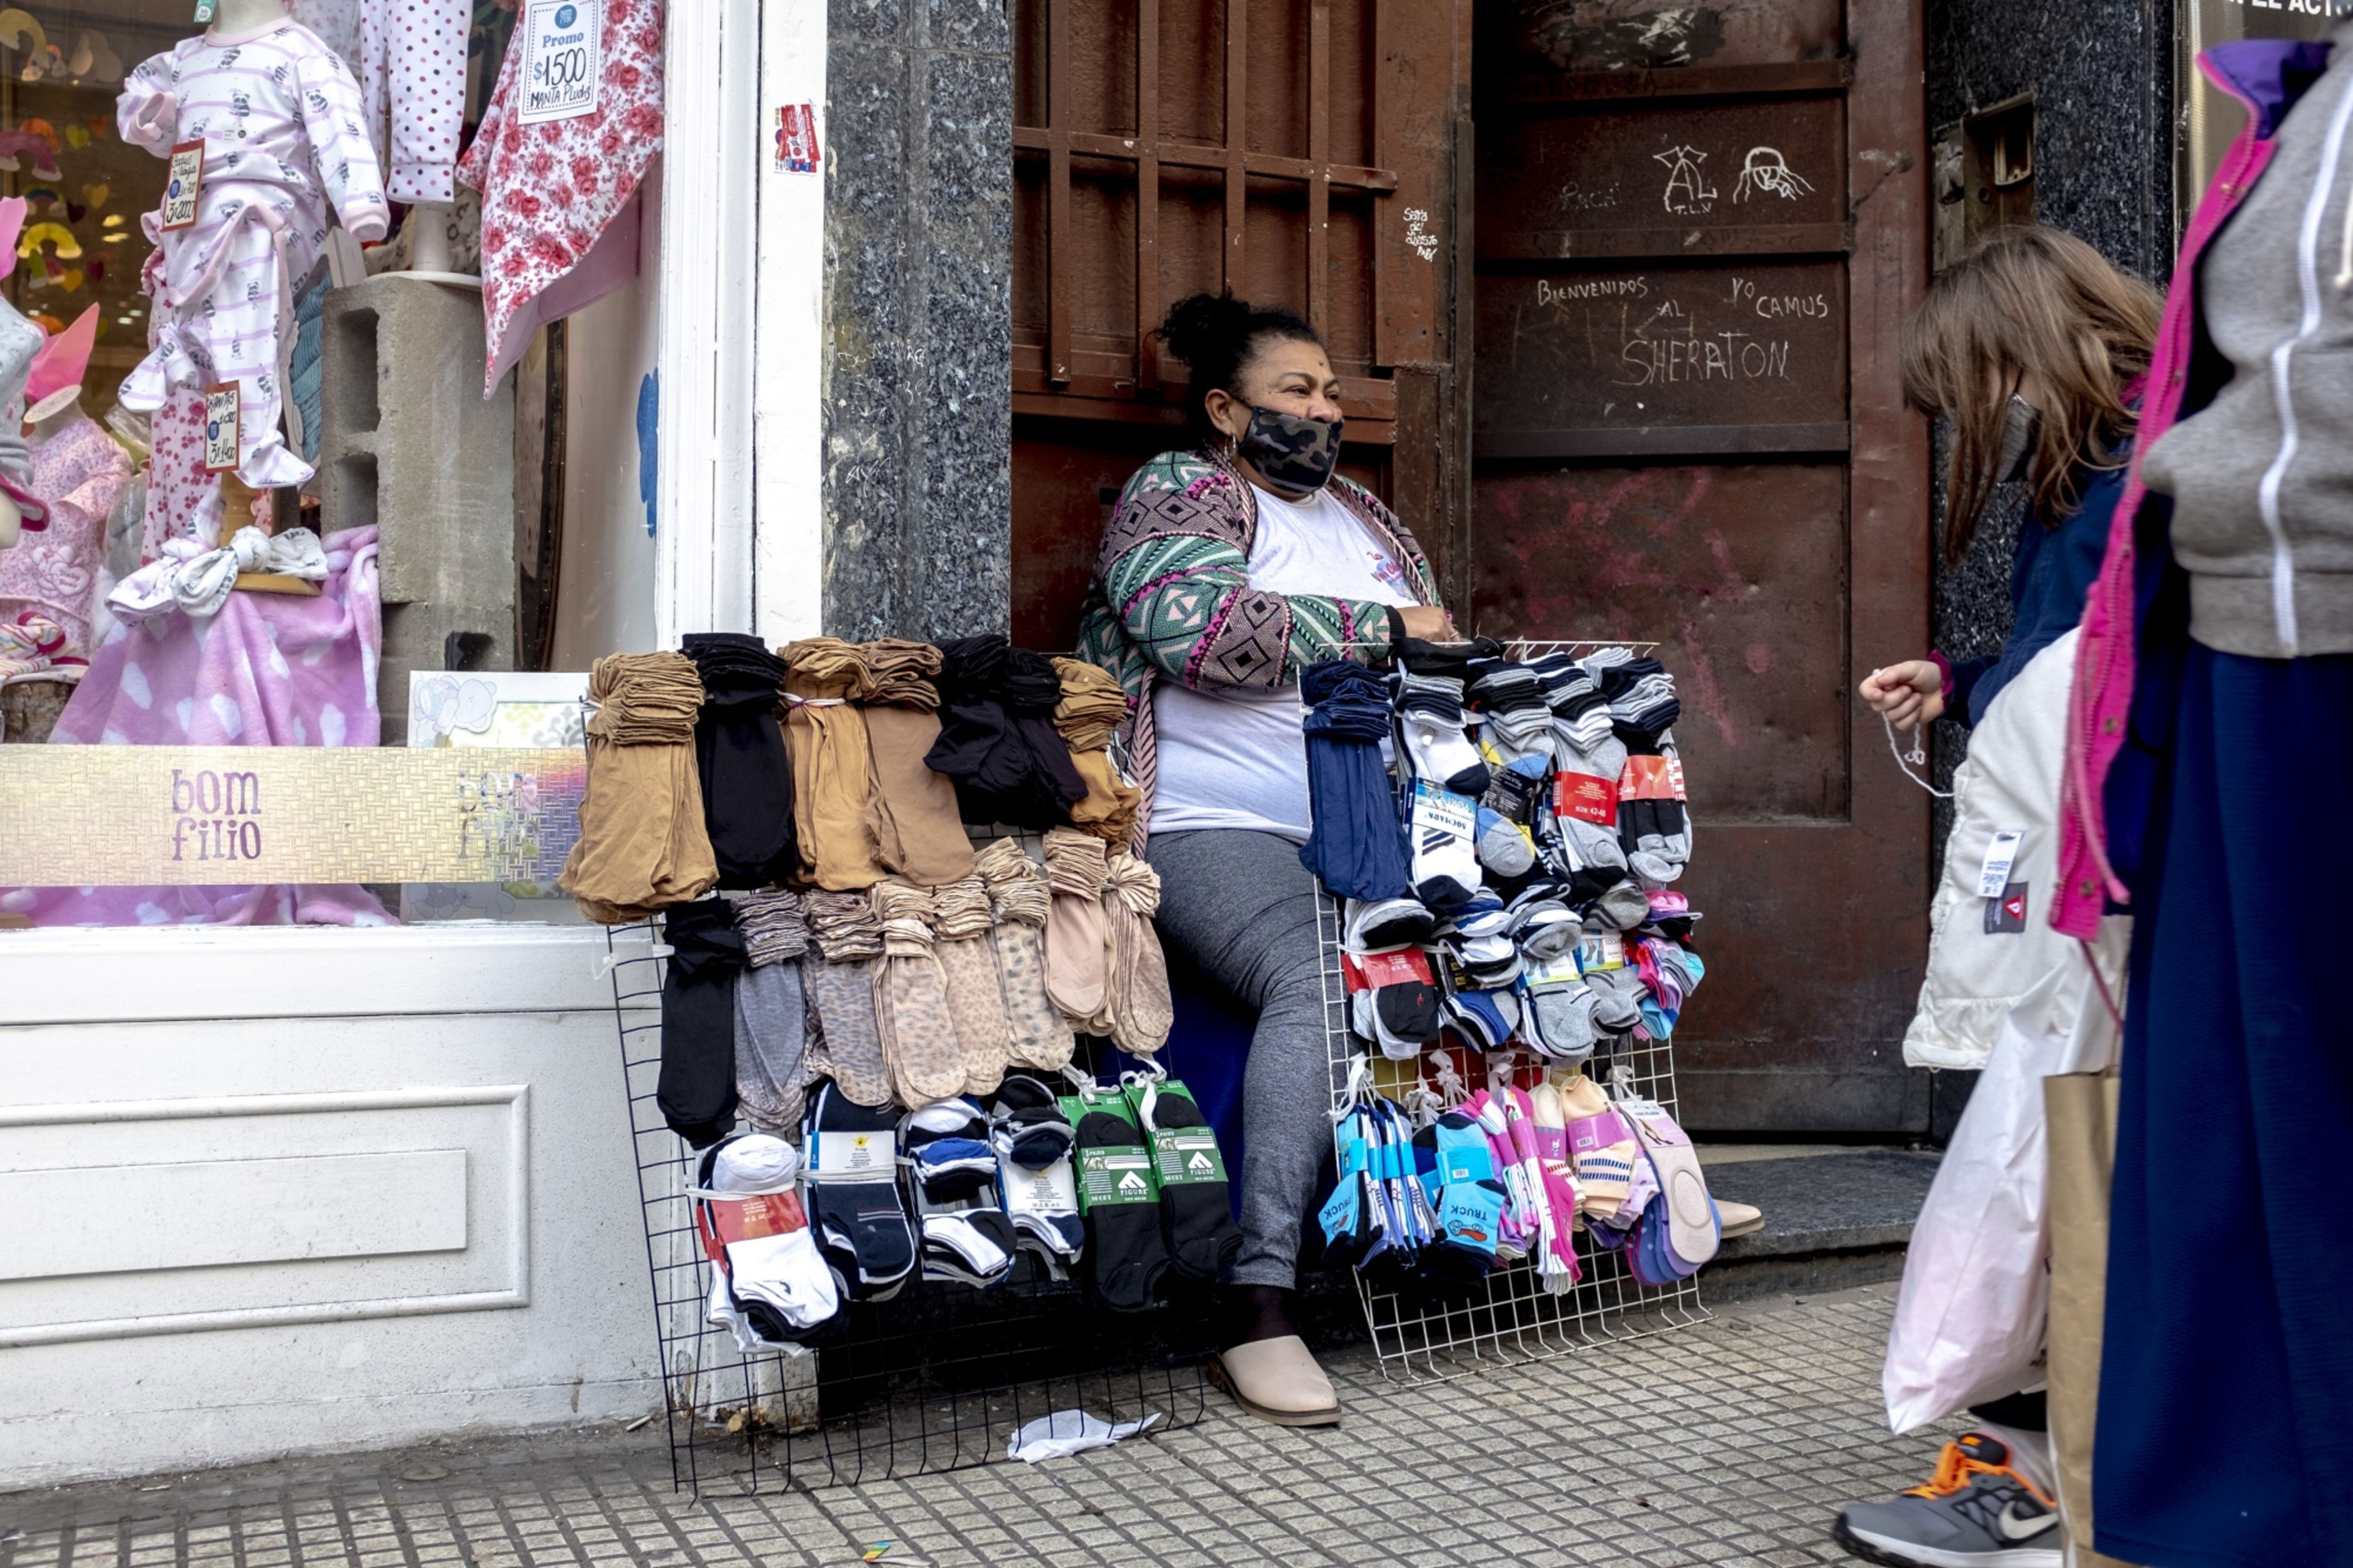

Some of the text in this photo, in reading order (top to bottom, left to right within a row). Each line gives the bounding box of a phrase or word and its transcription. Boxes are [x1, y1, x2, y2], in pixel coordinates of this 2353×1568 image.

[542, 32, 584, 48] Promo
[1756, 294, 1828, 318] CAMUS
[1612, 332, 1789, 385] SHERATON
[172, 769, 261, 815] bom
[172, 818, 261, 860] filio
[1450, 1205, 1488, 1221] TRUCK
